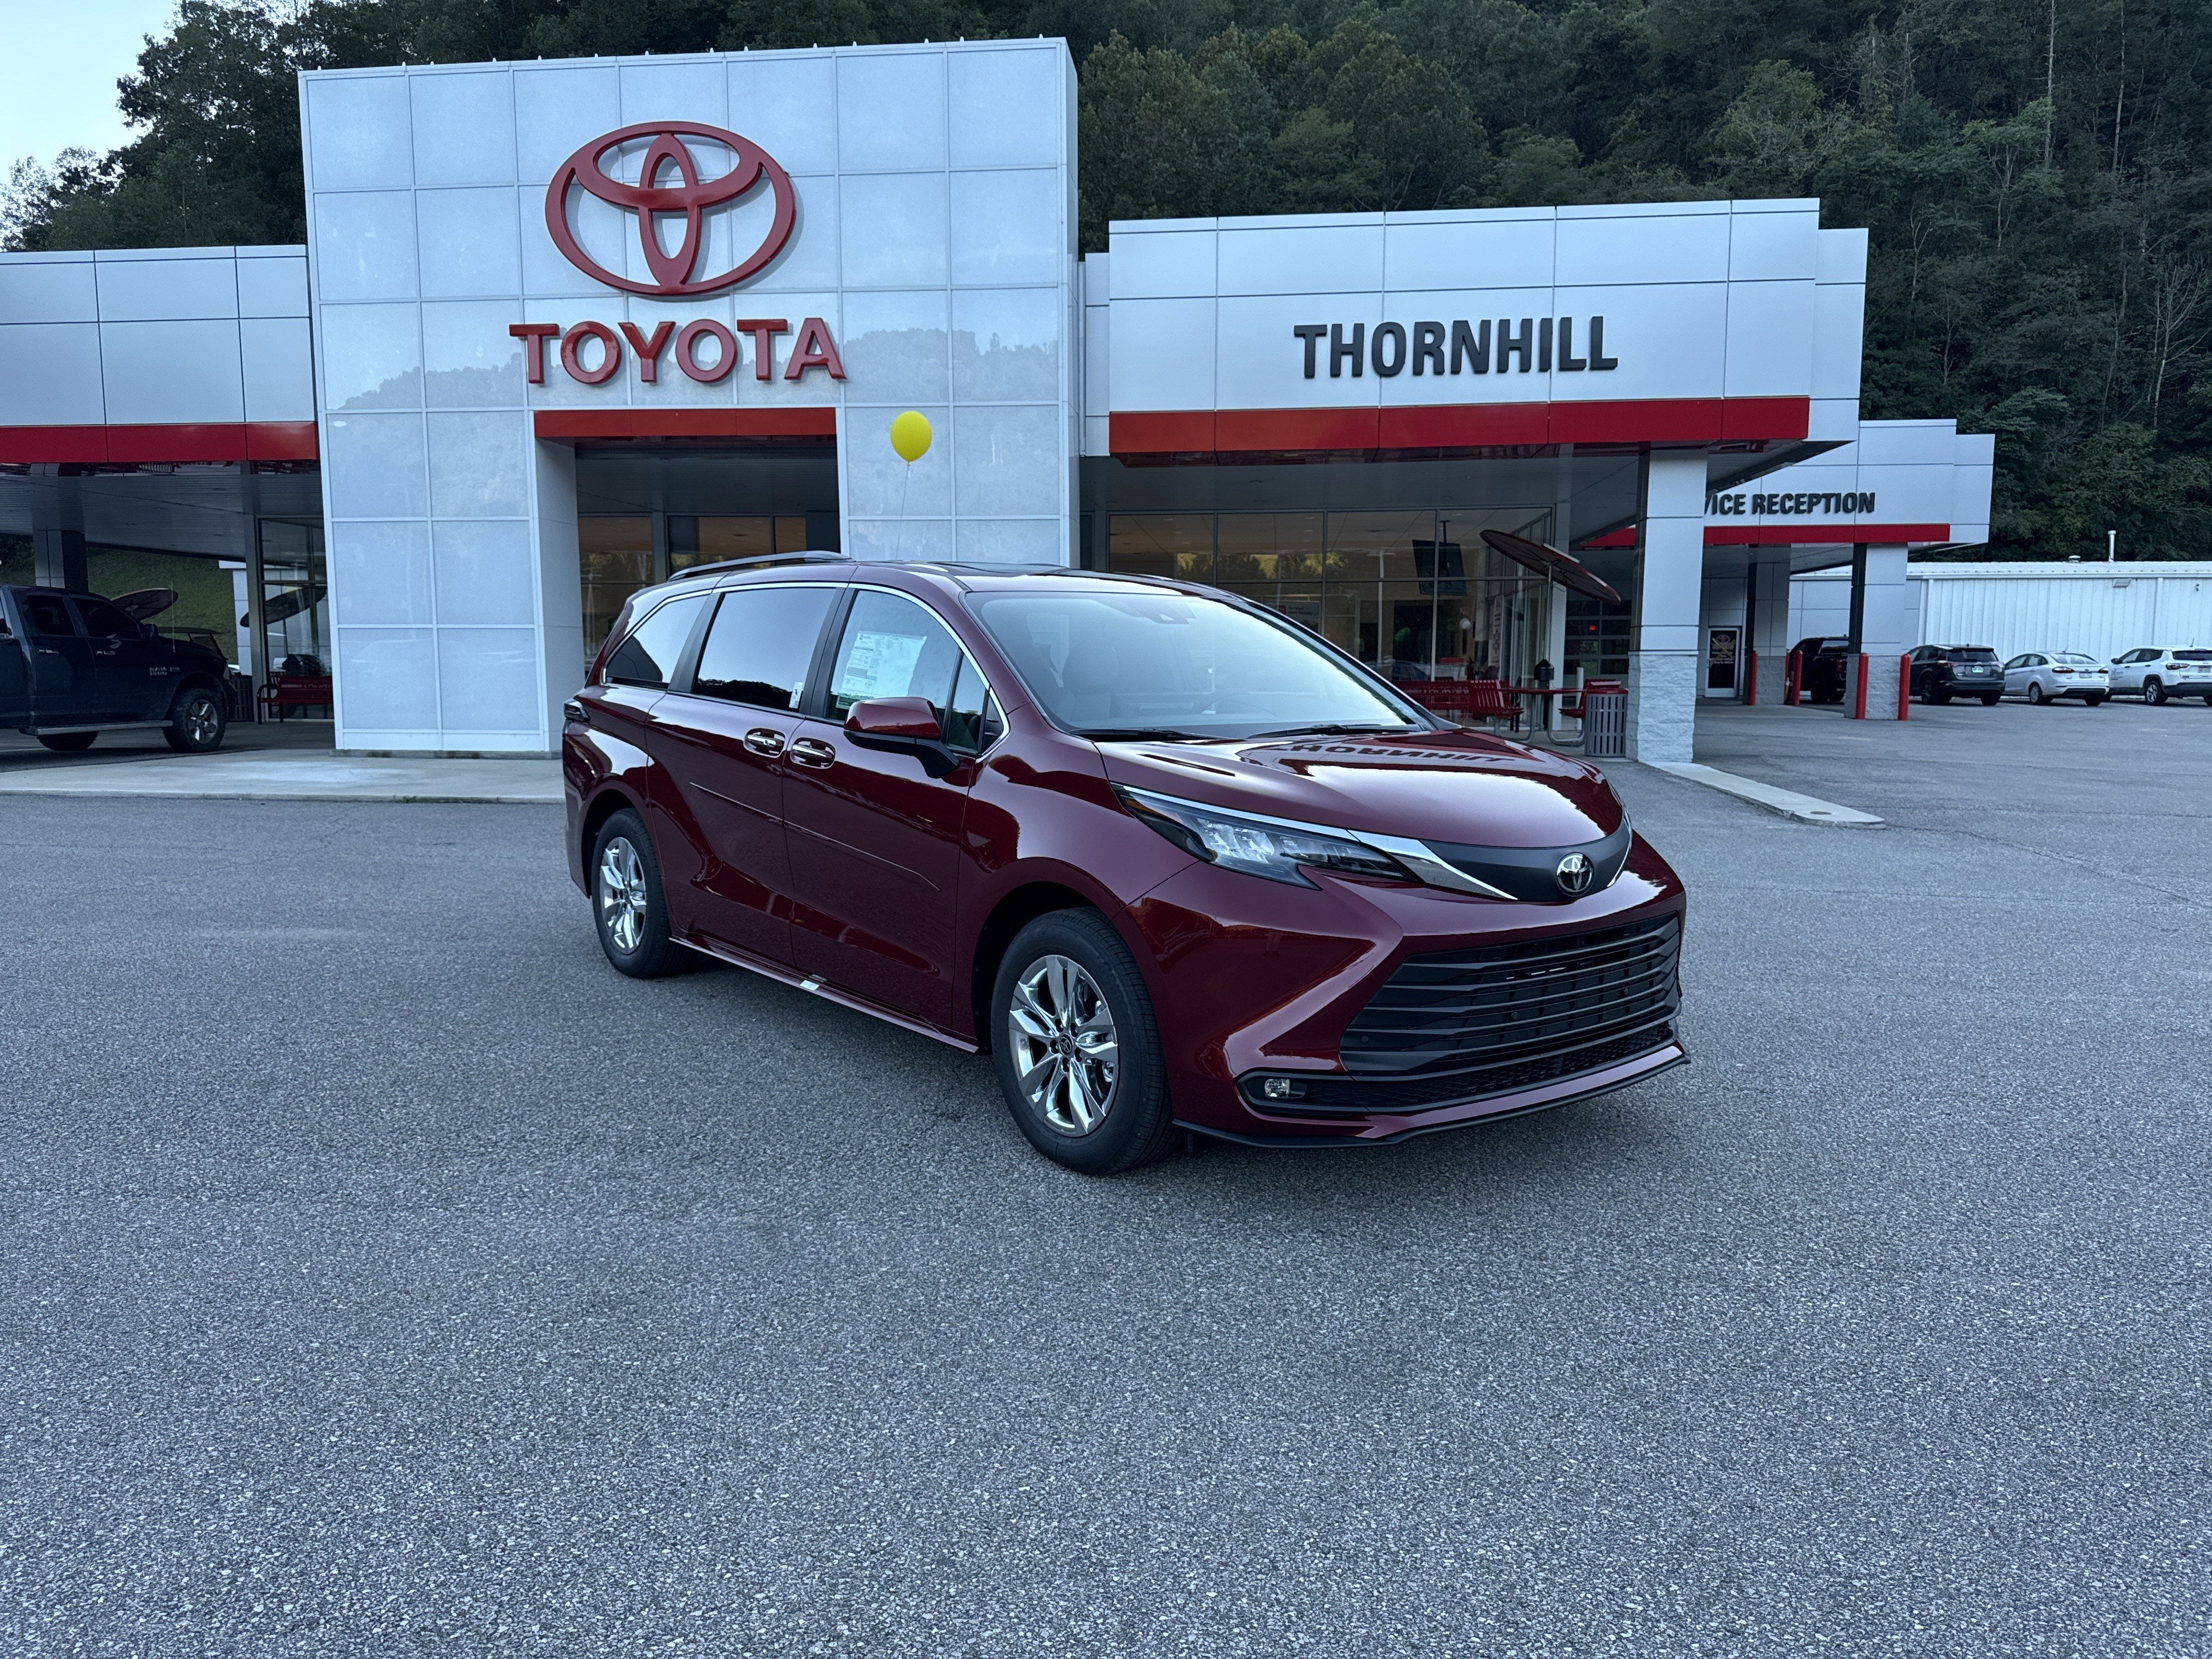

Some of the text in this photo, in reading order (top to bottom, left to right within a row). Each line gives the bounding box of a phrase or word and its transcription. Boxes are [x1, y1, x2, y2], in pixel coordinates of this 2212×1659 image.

[509, 318, 847, 384] TOYOTA
[1294, 316, 1618, 379] THORNHILL
[1752, 492, 1875, 515] RECEPTION
